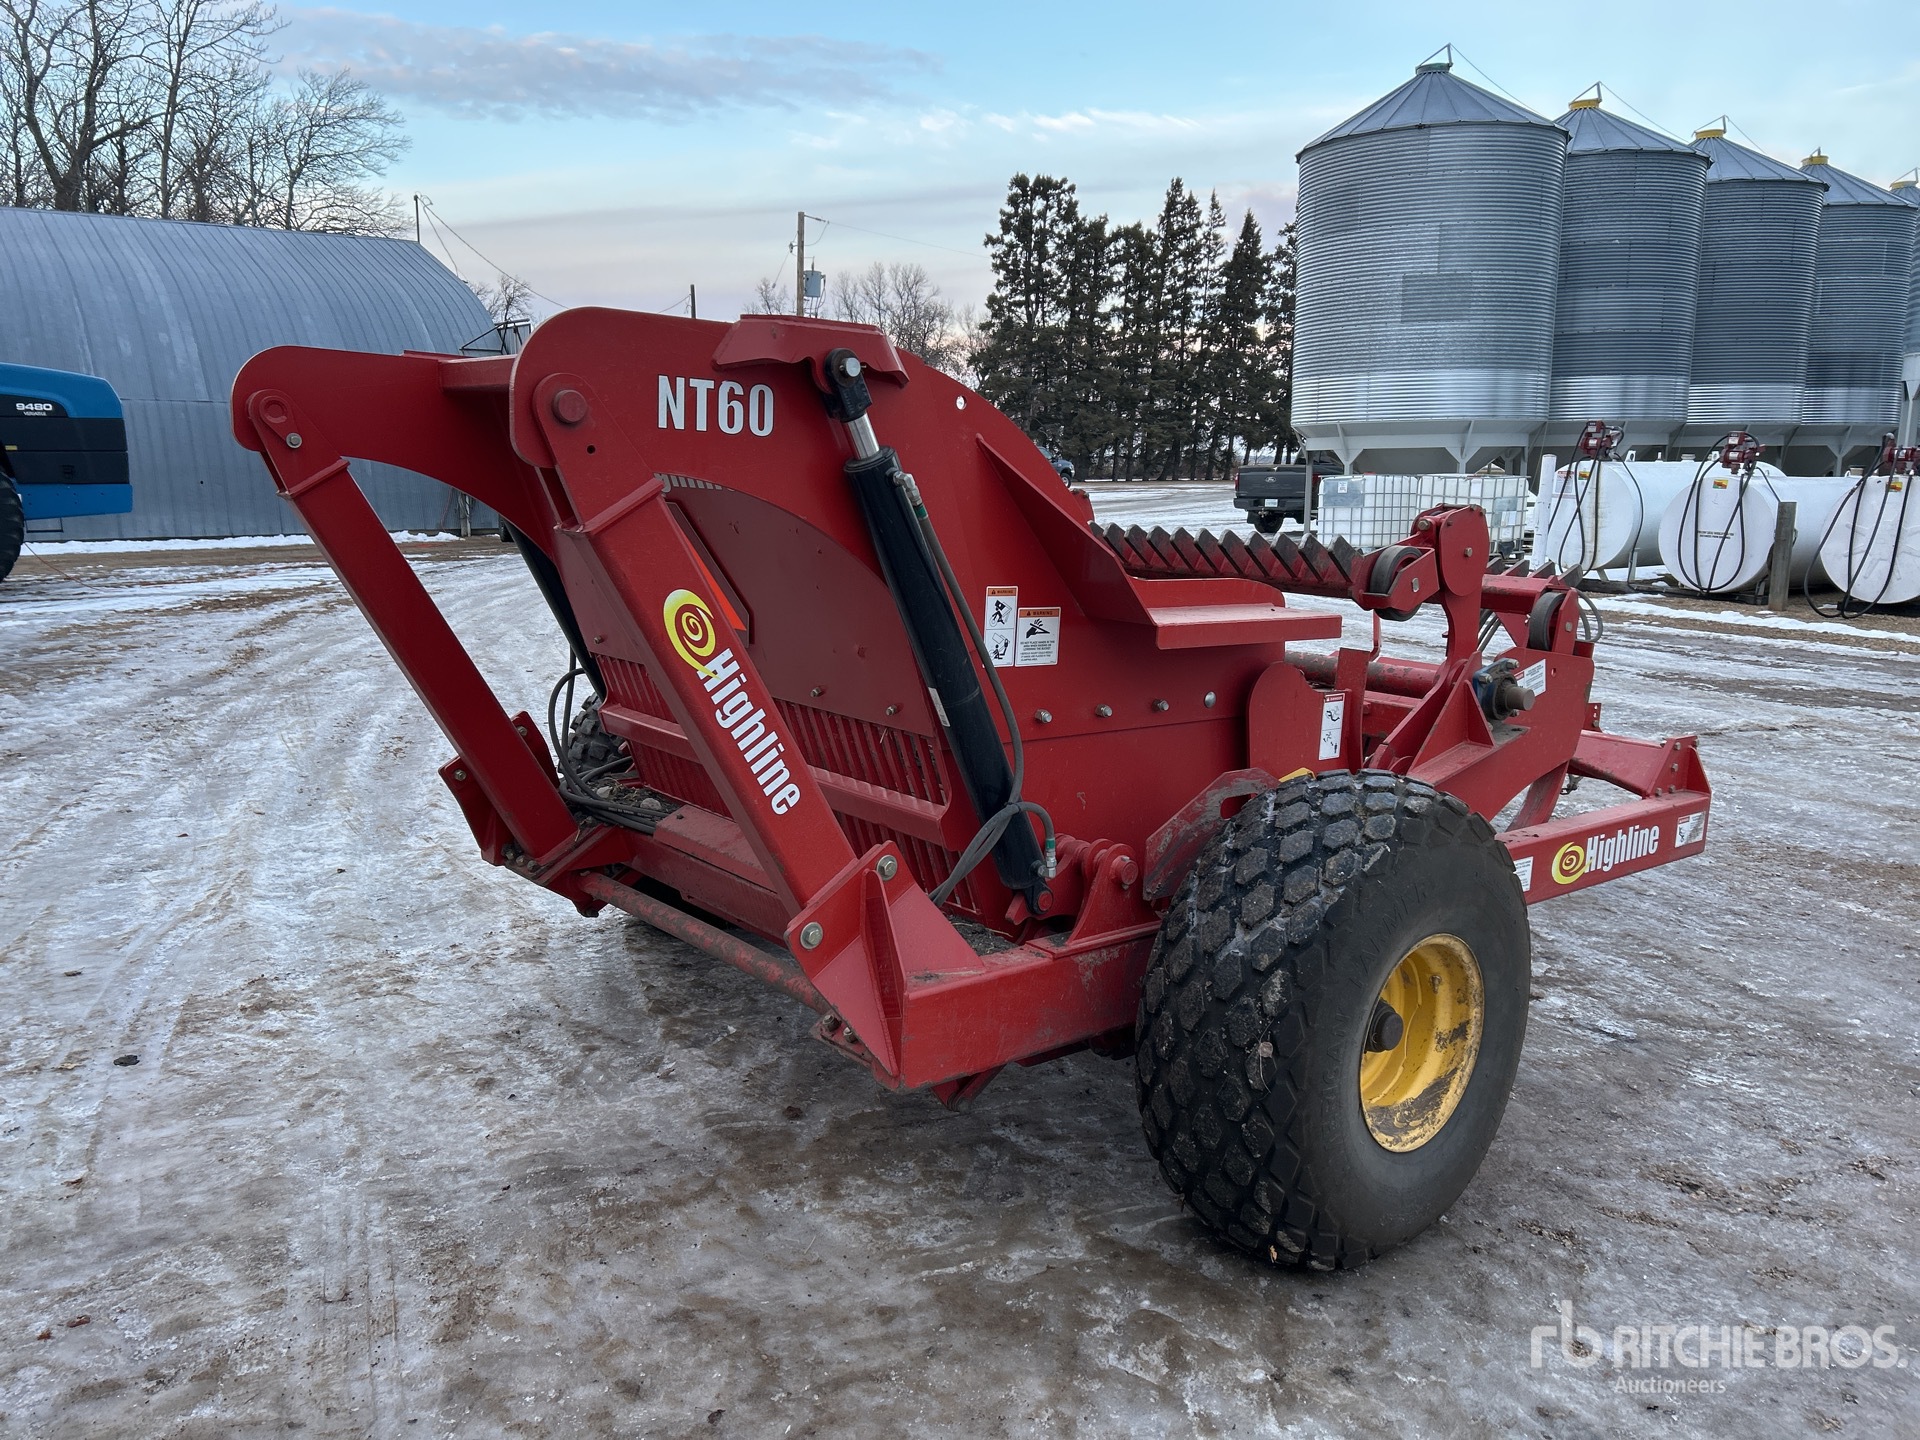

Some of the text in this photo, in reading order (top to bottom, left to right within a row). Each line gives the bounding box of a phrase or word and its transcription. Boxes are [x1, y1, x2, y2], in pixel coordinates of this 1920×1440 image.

[16, 403, 52, 411] 9480
[658, 375, 774, 437] NT60
[697, 648, 800, 815] Highline
[1584, 825, 1660, 873] Highline
